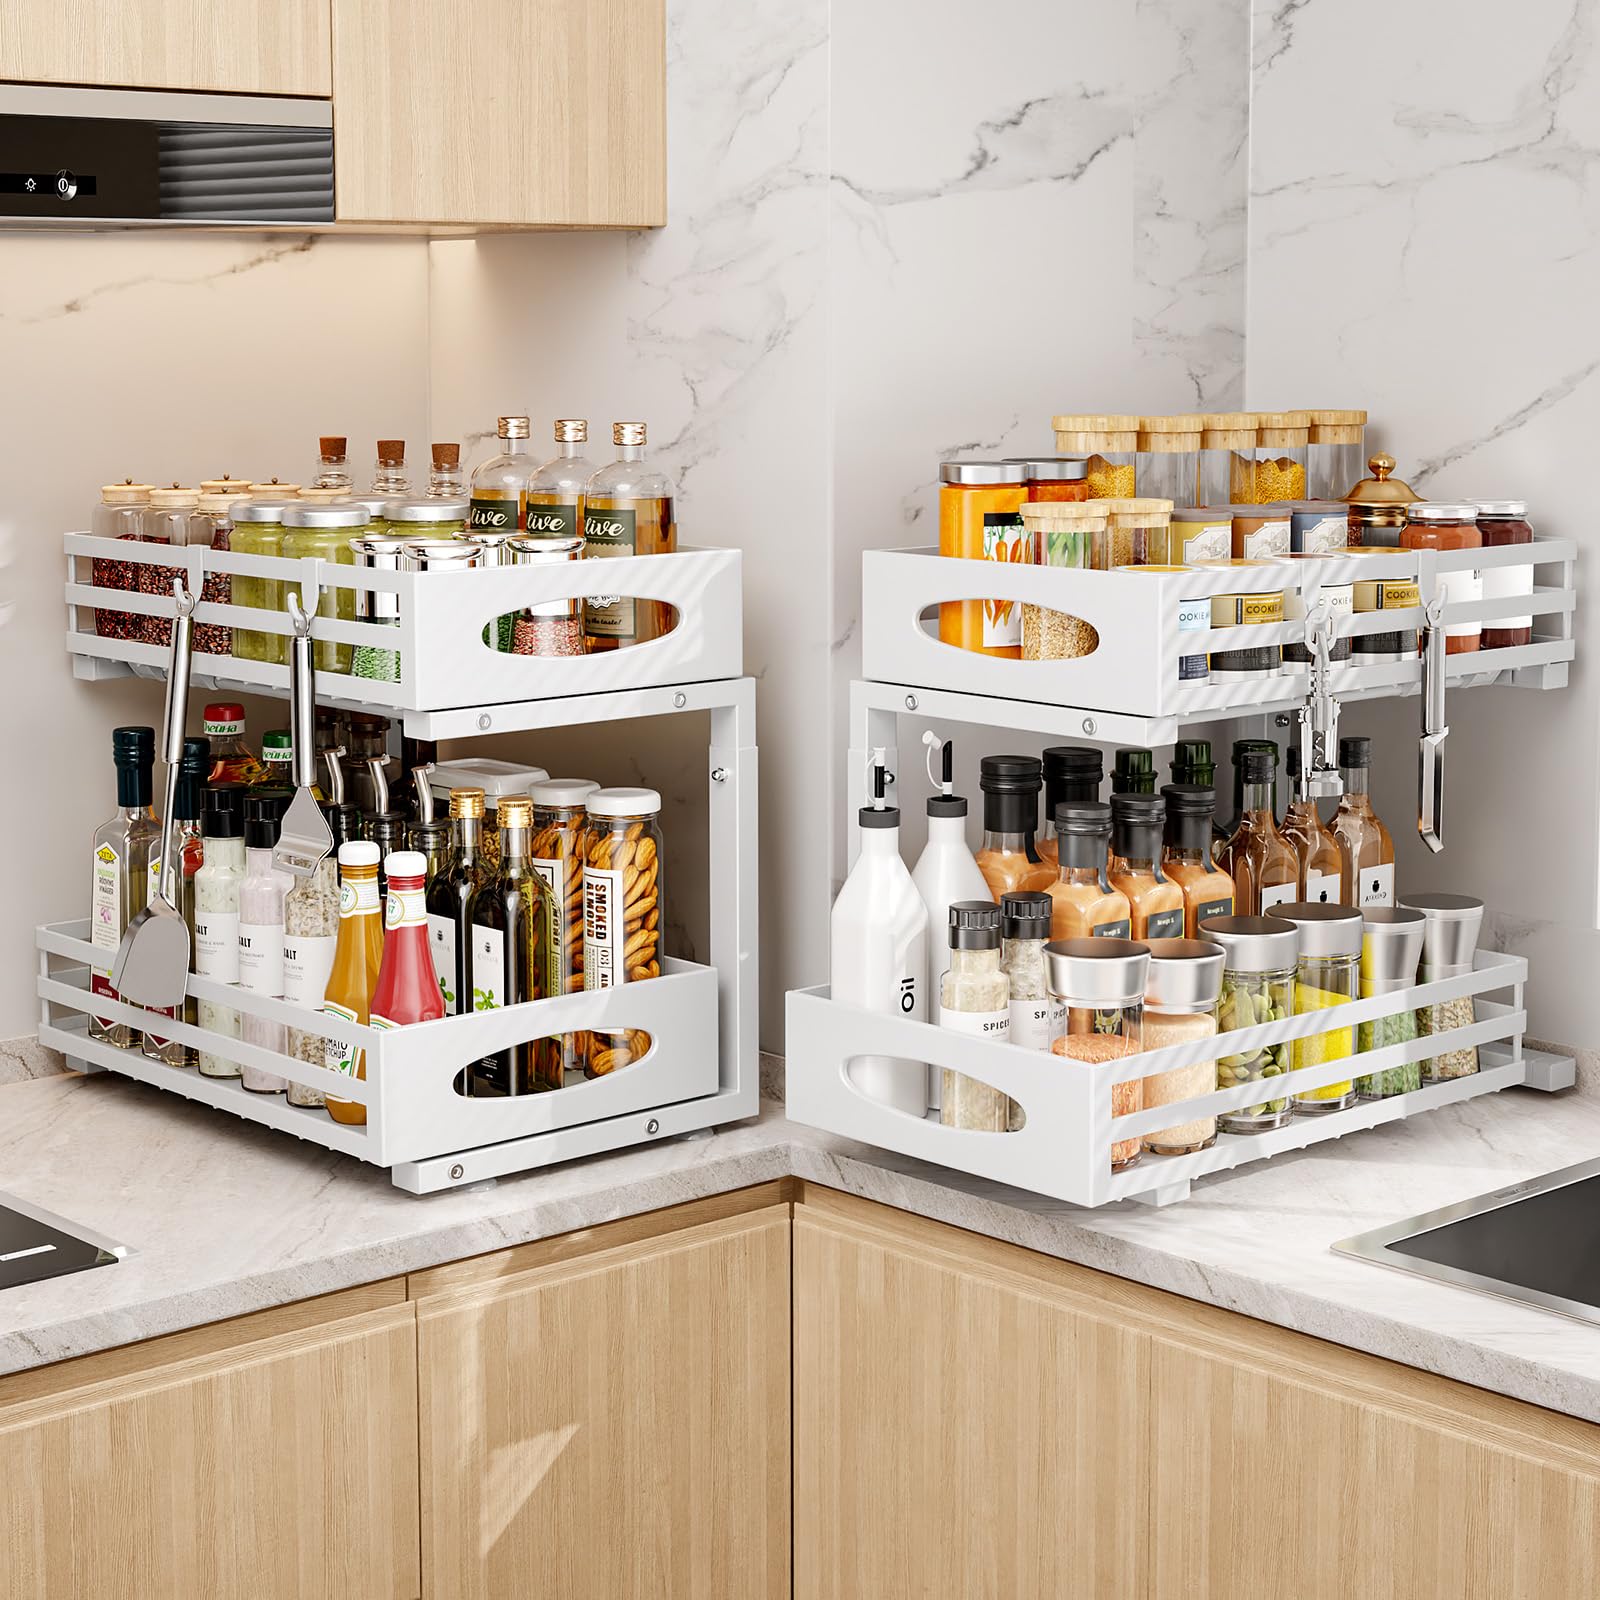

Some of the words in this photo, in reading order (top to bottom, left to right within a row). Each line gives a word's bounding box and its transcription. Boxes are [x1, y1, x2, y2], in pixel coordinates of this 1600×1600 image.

[527, 512, 565, 531] live
[585, 517, 625, 536] live
[1179, 612, 1205, 622] OOKIE
[586, 881, 595, 938] ALMOND
[595, 884, 607, 940] SMOKED
[238, 935, 252, 948] ALT
[901, 977, 915, 1013] Oil
[325, 1047, 347, 1060] ETCHUP
